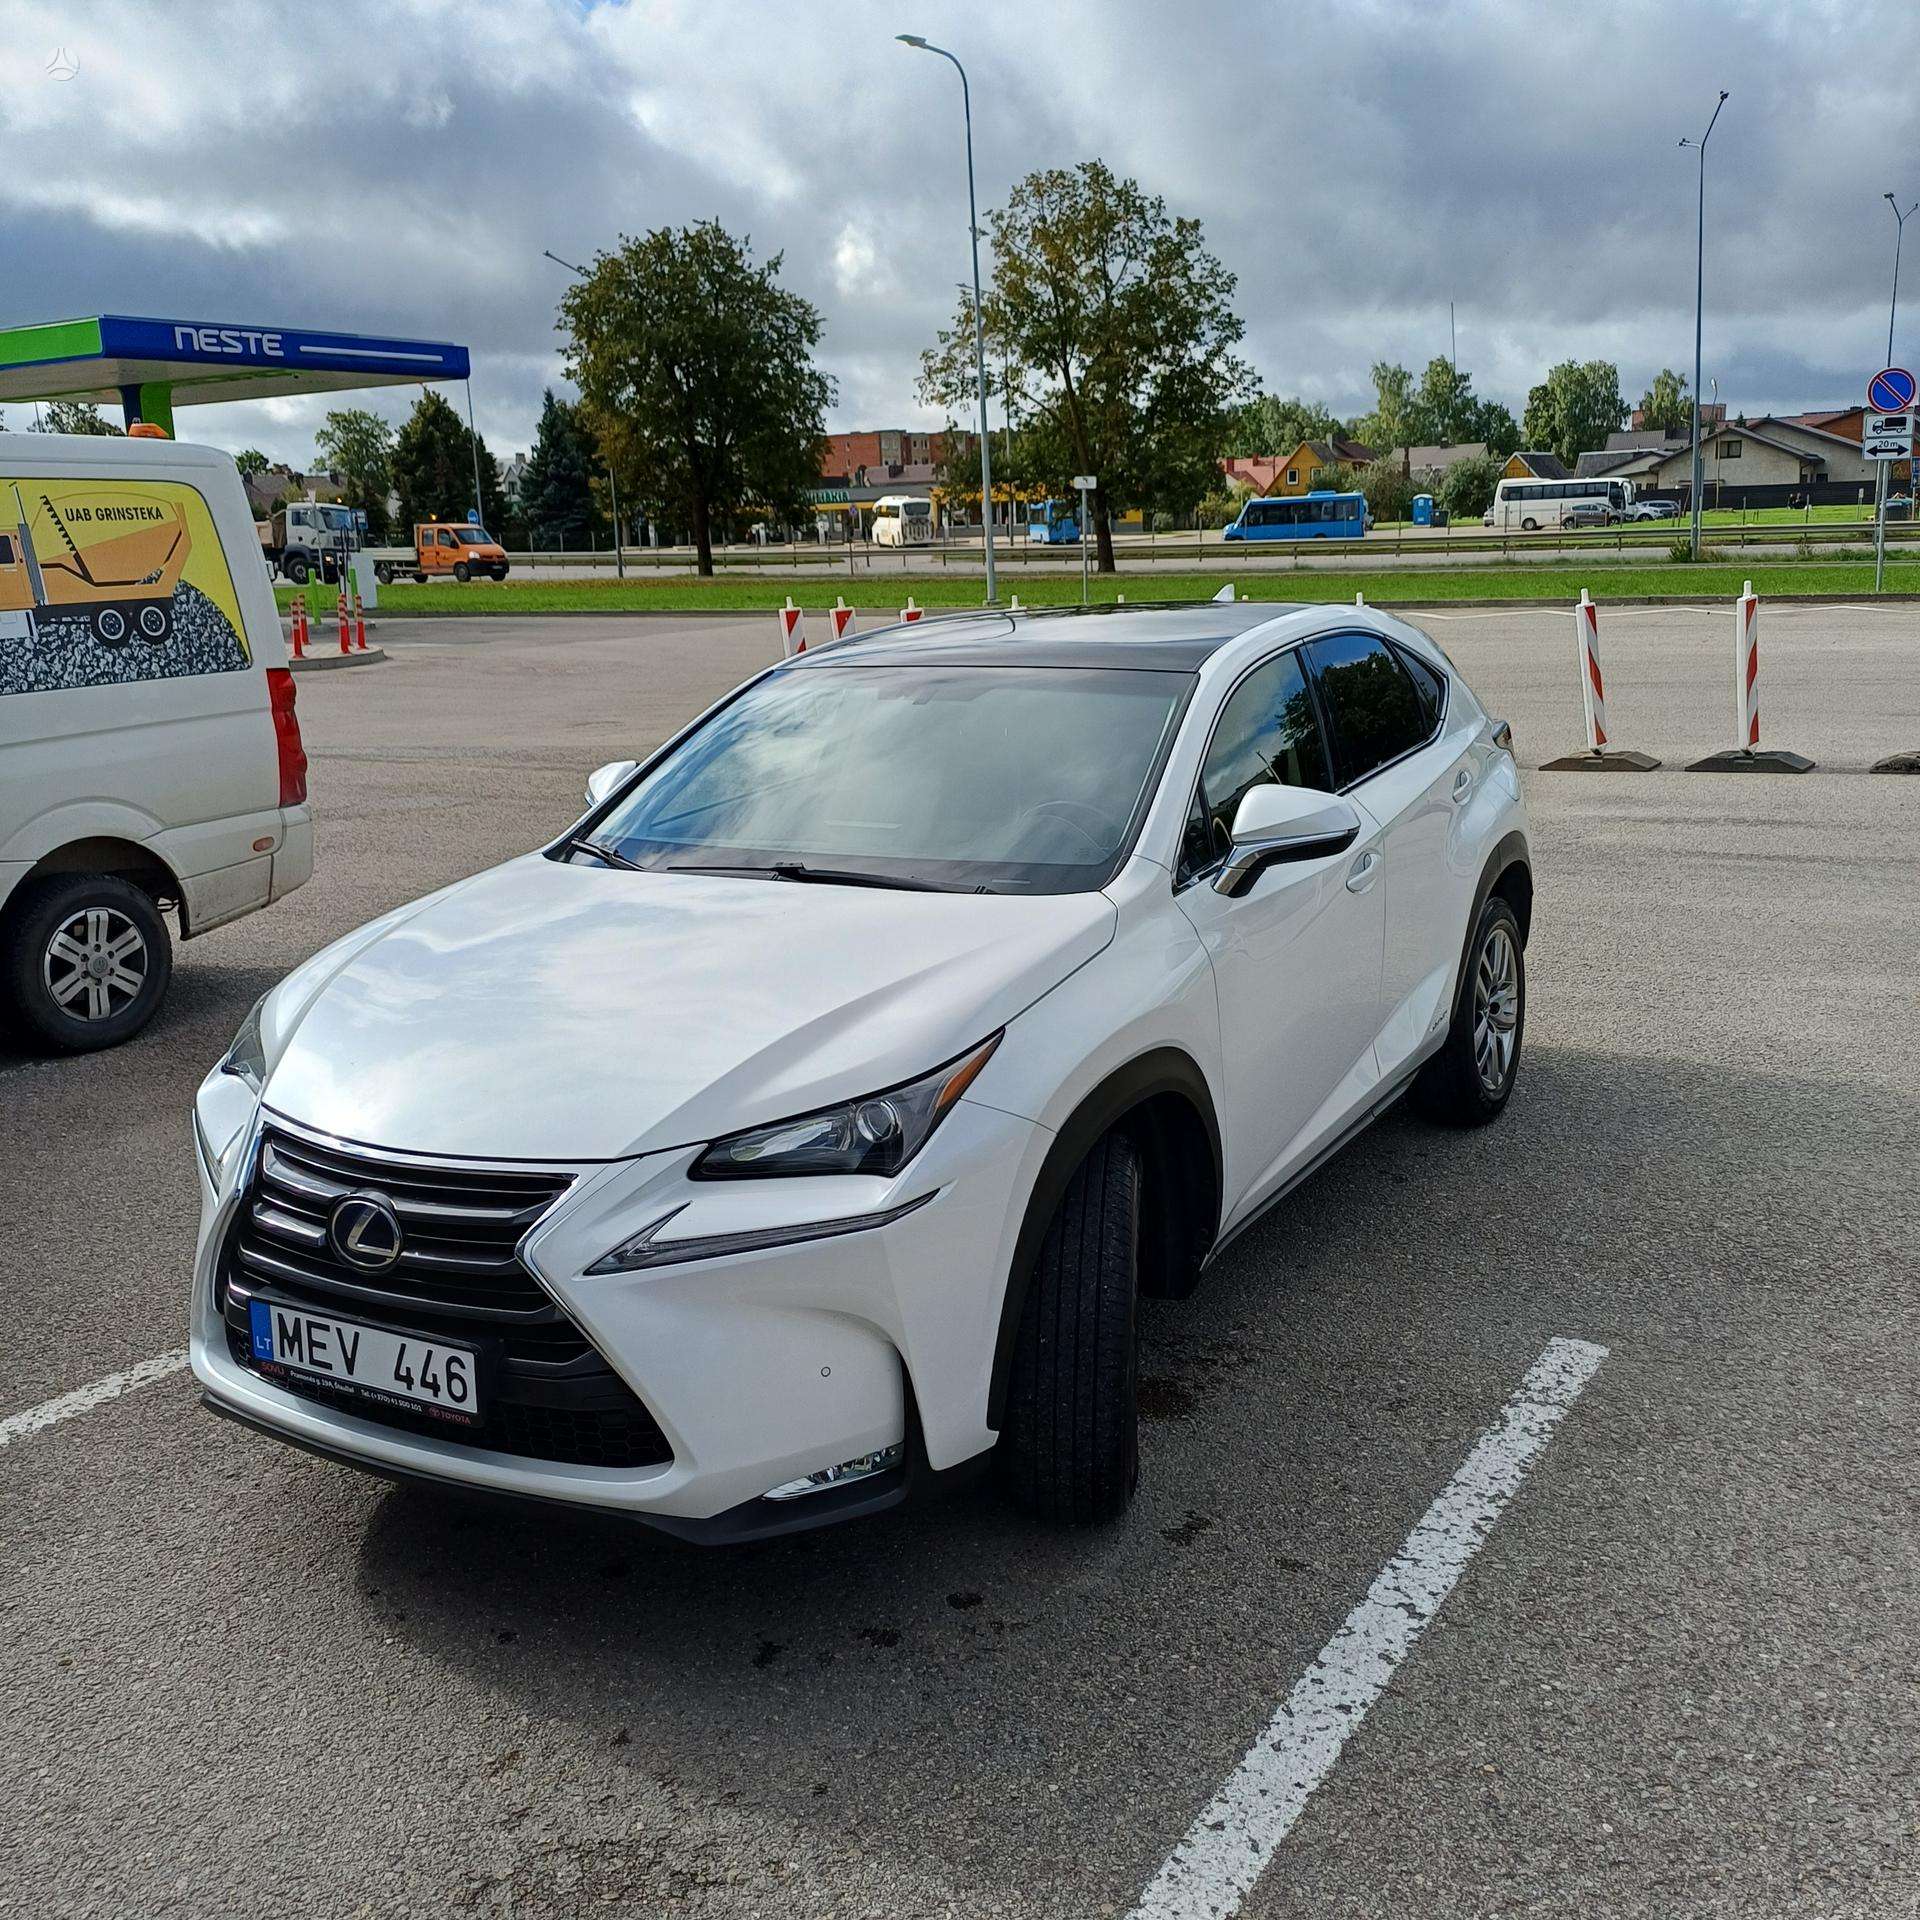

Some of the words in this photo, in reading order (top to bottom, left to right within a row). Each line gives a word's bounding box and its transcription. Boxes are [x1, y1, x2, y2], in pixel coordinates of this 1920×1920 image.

[174, 326, 284, 356] NESTE
[1878, 440, 1889, 448] 20
[65, 508, 92, 521] UAB
[95, 506, 164, 521] GRINSTEKA
[256, 1336, 272, 1350] LT
[277, 1312, 360, 1376] MEV
[394, 1342, 468, 1404] 446
[440, 1411, 471, 1425] TOYOTA
